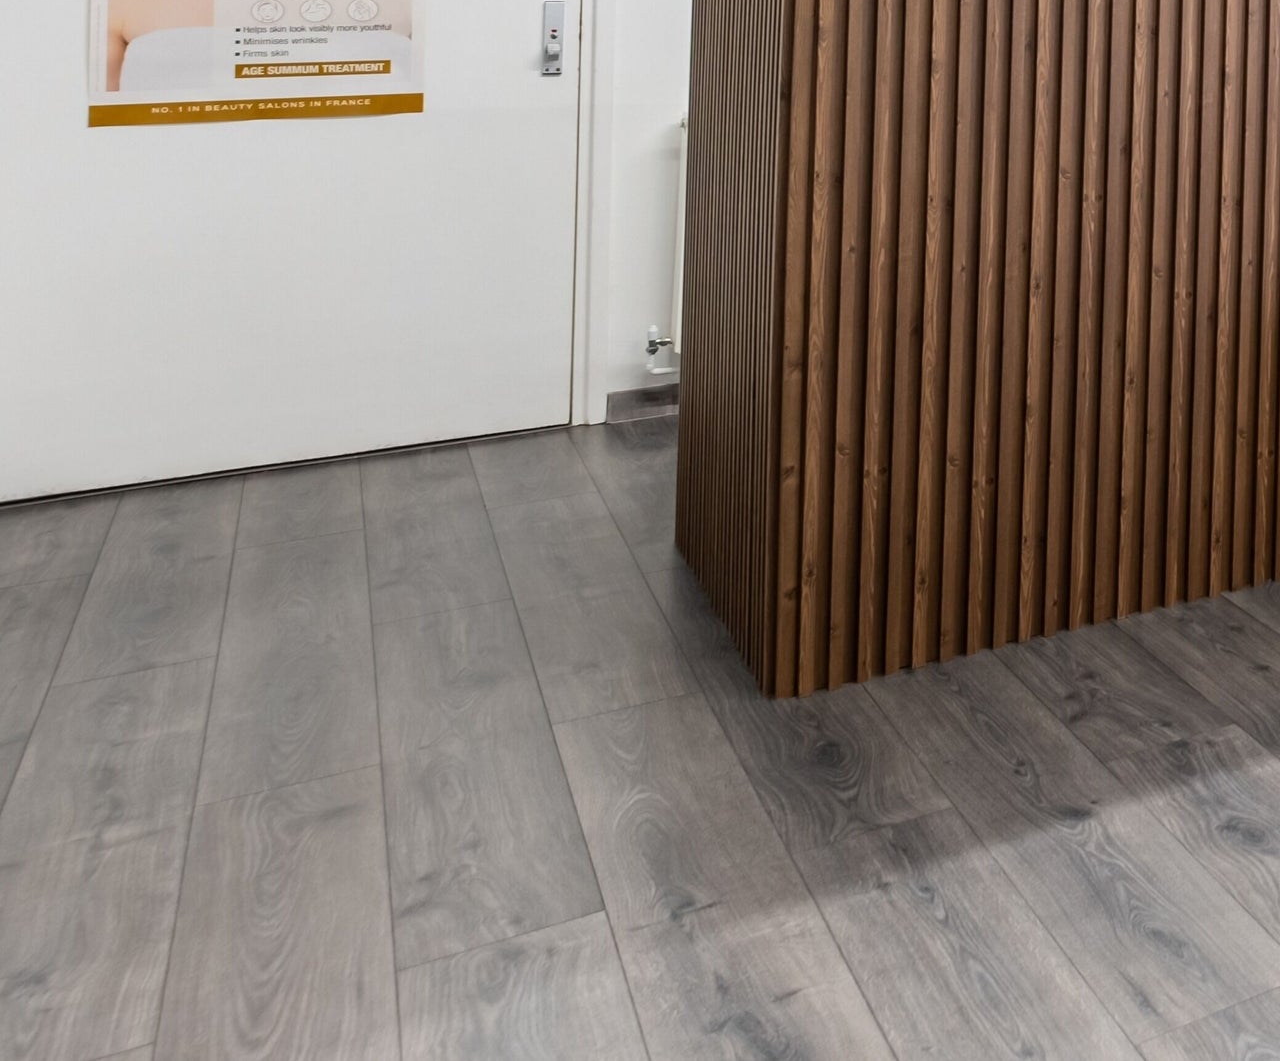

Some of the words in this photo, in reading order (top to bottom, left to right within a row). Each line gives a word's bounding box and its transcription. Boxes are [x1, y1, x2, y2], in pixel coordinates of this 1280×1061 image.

[243, 26, 268, 35] Helps
[269, 25, 287, 33] skin
[289, 25, 306, 33] look
[309, 24, 334, 34] visibly
[360, 24, 392, 33] youthful
[243, 37, 289, 45] Minimises
[291, 36, 328, 44] wrinkles
[243, 49, 268, 57] Firms
[271, 49, 289, 57] skin
[242, 66, 264, 76] AGE
[267, 64, 319, 75] SUMMUM
[322, 62, 385, 73] TREATMENT
[205, 104, 253, 112] BEAUTY
[258, 101, 305, 109] SALONS
